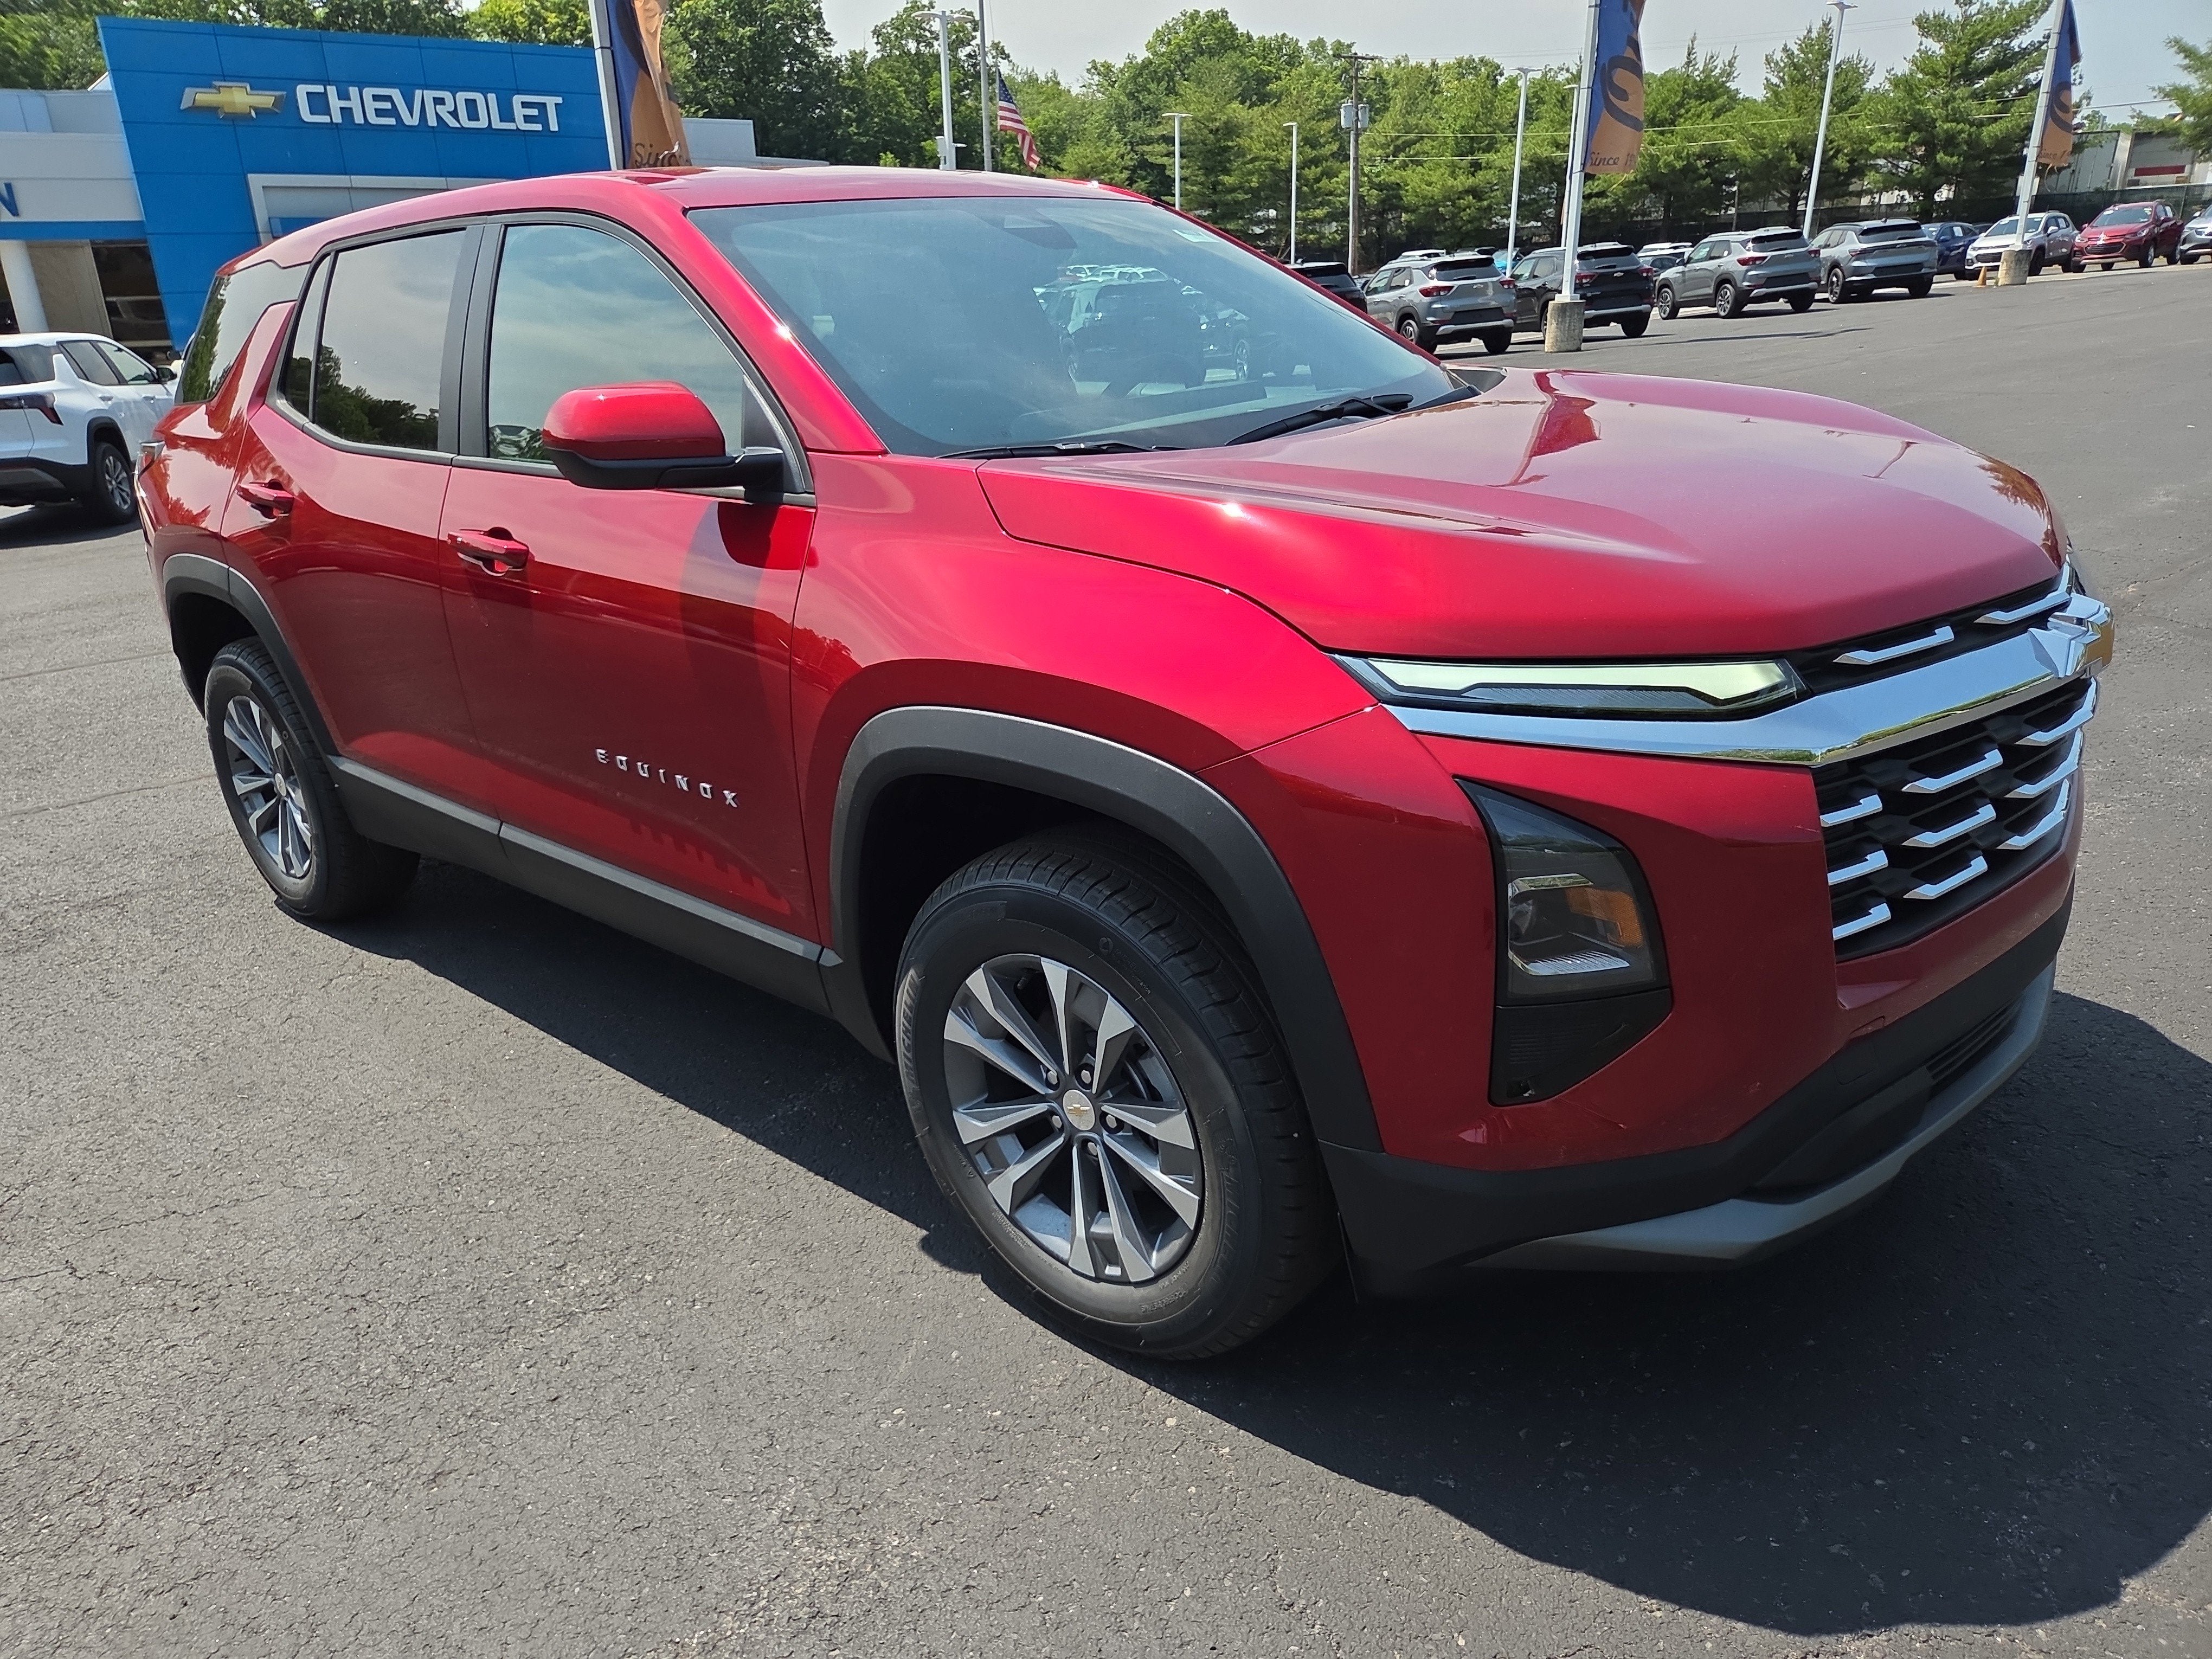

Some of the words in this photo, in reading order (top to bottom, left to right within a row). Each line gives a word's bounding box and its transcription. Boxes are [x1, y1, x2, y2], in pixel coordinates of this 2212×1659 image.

[296, 84, 563, 132] CHEVROLET
[595, 748, 740, 808] EQUINOX
[902, 974, 921, 1083] MICHELIN
